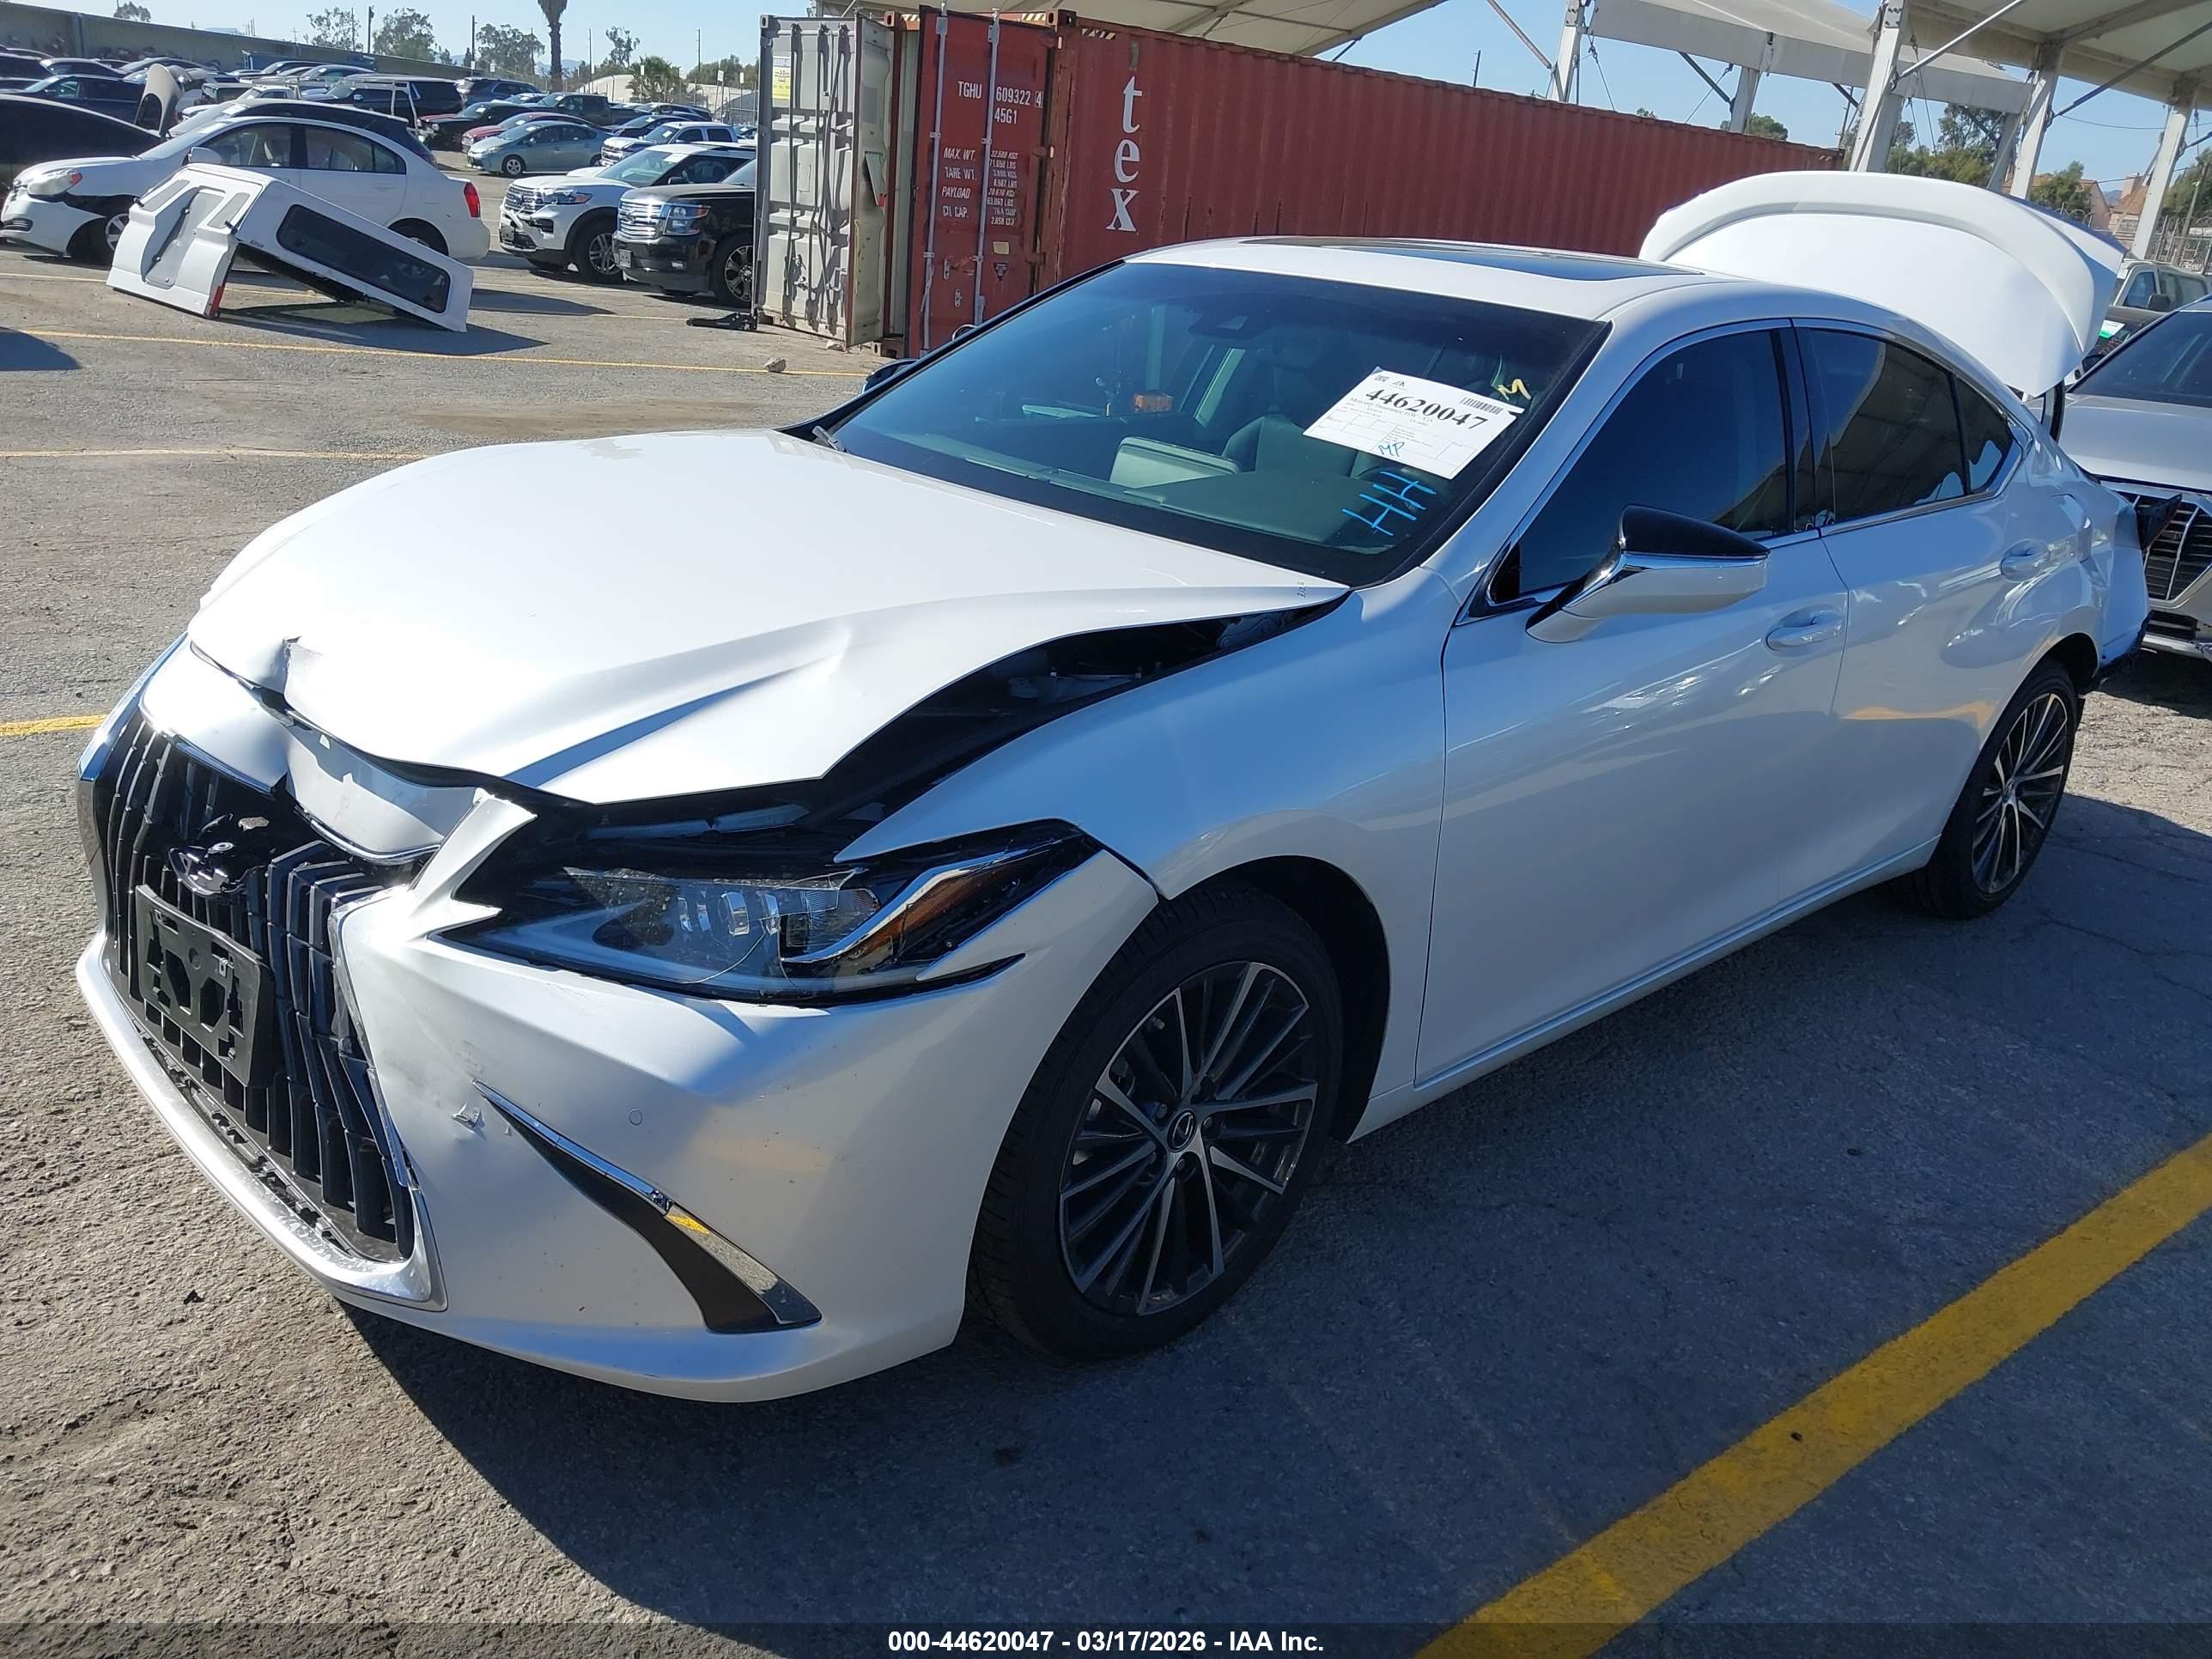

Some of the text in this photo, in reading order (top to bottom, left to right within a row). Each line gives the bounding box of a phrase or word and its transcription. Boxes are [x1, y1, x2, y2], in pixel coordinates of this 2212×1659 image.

[957, 81, 1043, 108] TGHU 609322 4
[994, 107, 1018, 125] 45G1
[1106, 75, 1143, 232] tex
[945, 167, 961, 179] TARE
[941, 185, 971, 199] PAYLOAD
[1365, 389, 1489, 429] 44620047
[1377, 441, 1406, 458] MP
